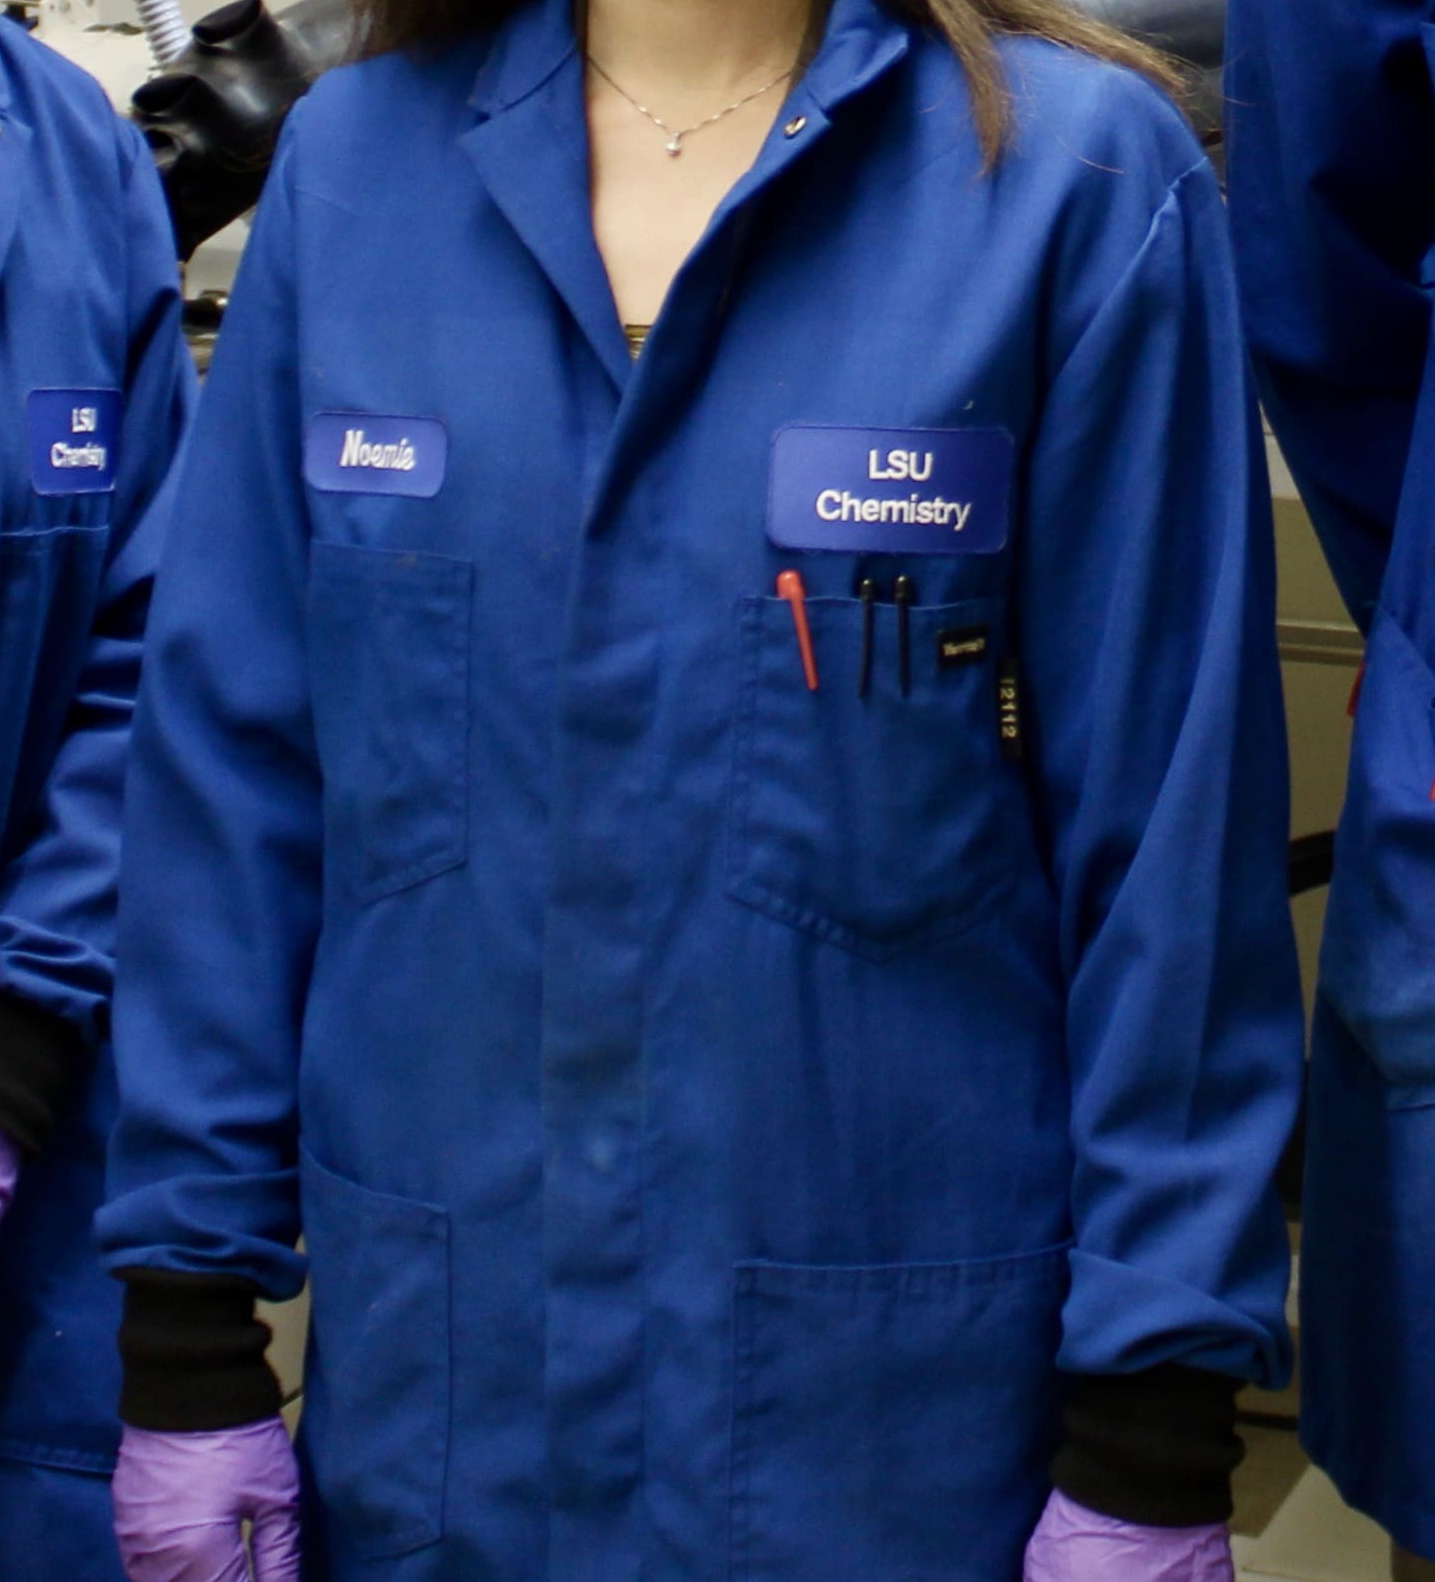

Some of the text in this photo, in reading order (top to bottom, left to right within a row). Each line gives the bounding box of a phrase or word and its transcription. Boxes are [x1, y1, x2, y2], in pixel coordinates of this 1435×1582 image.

[339, 428, 417, 472] Noemie
[868, 448, 935, 482] LSU
[815, 489, 973, 532] Chemistry
[999, 686, 1019, 739] 2112
